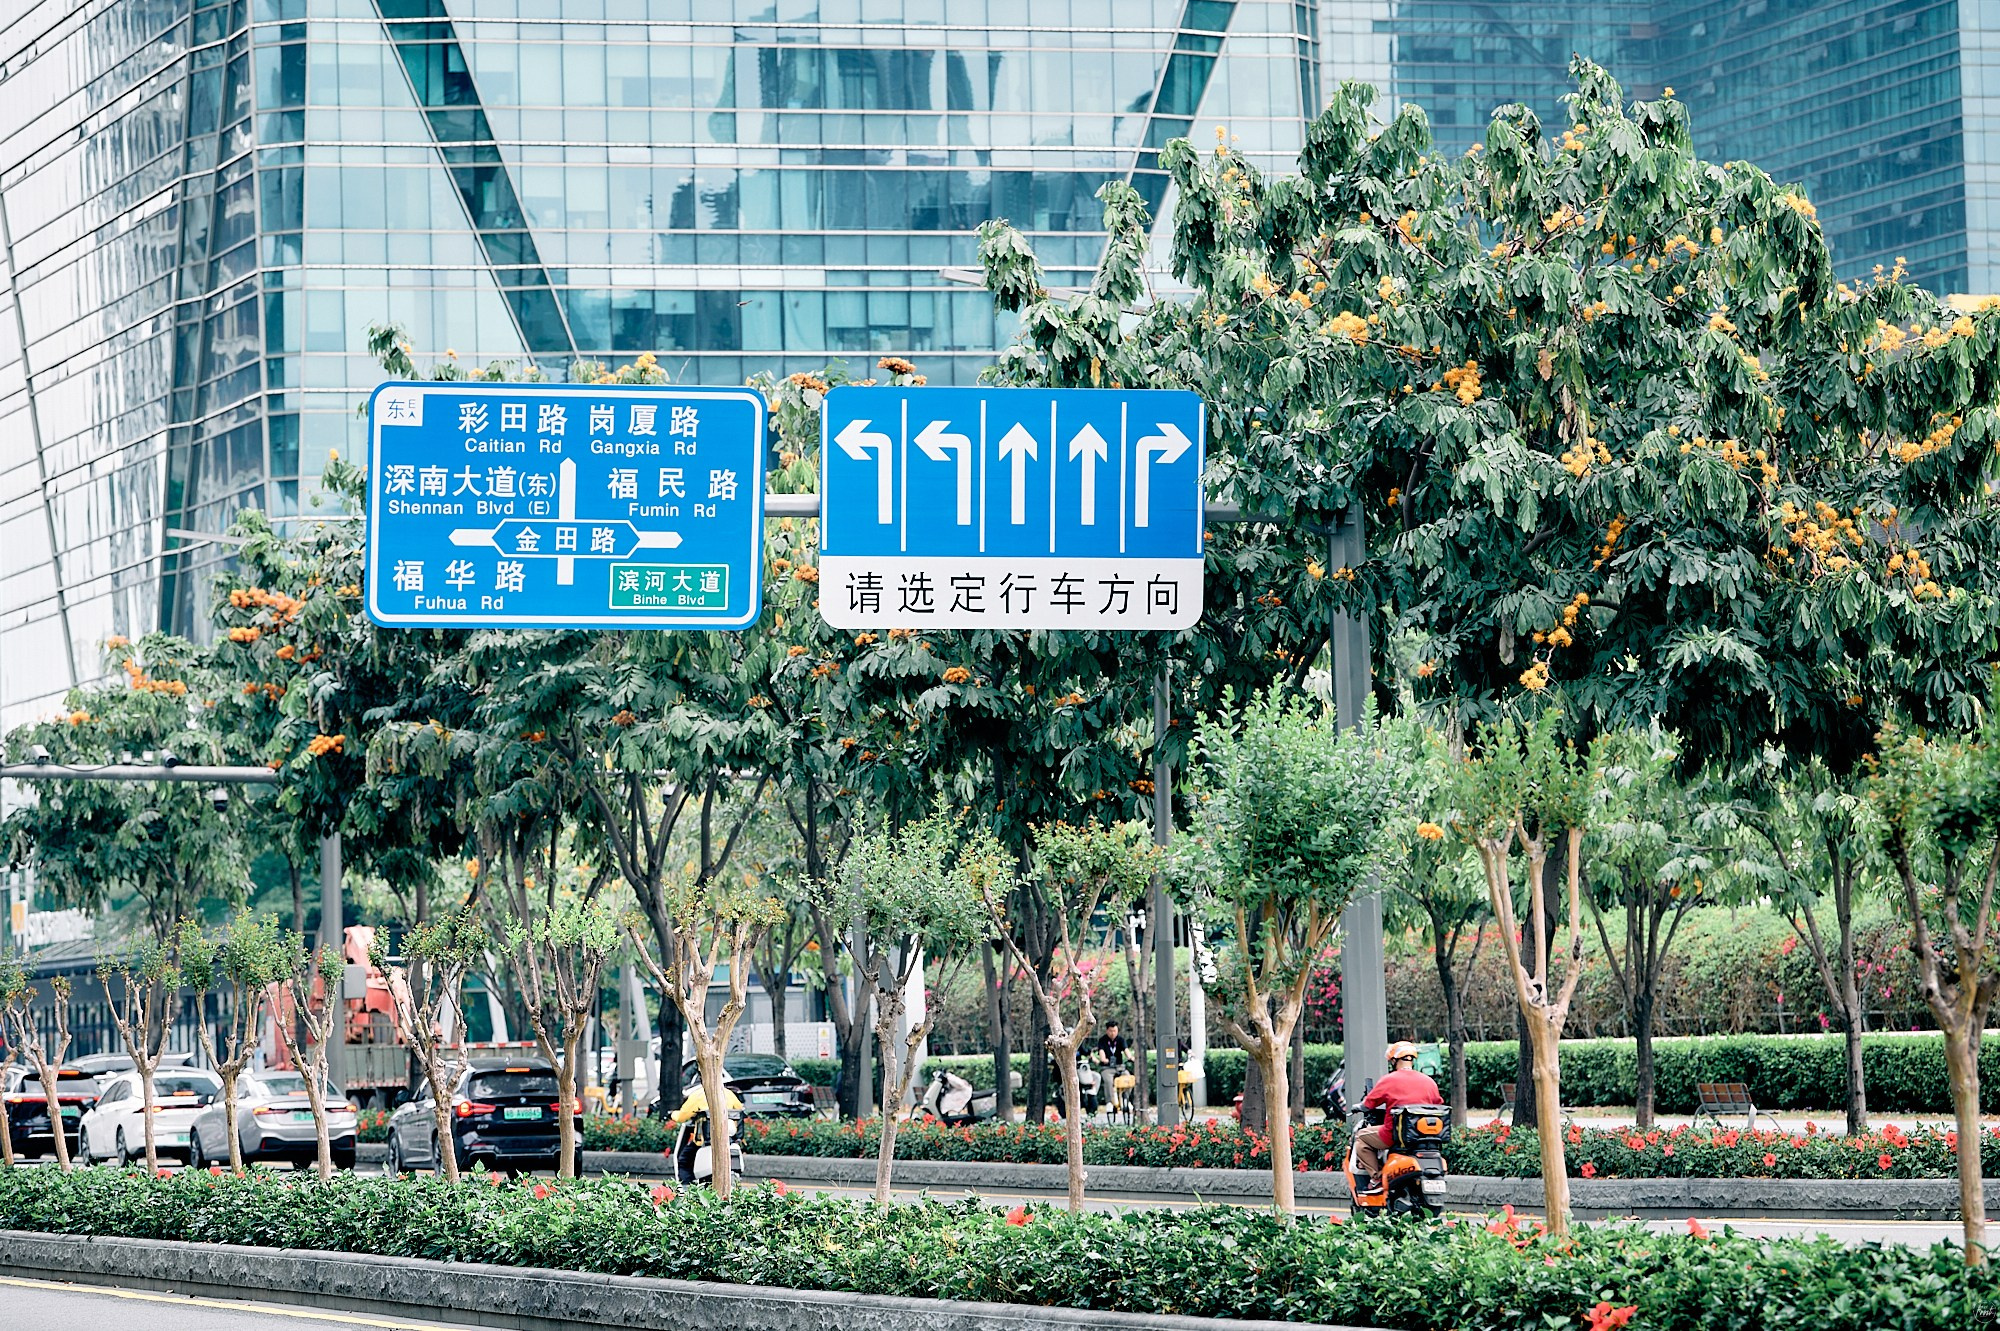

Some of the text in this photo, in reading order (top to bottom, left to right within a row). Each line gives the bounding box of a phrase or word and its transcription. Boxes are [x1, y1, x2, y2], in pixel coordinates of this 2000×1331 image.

[387, 399, 405, 419] 东
[408, 399, 416, 408] E
[459, 402, 567, 436] 彩田路
[590, 403, 699, 437] 岗厦路
[464, 438, 562, 454] Caitian Rd
[591, 440, 697, 458] Gangxia Rd
[608, 468, 739, 501] 福民路
[388, 500, 551, 515] Shennan Blvd (E)
[628, 503, 716, 518] Fumin Rd
[515, 526, 616, 554] 金田路
[393, 560, 526, 593] 福华路
[618, 570, 721, 593] 滨河大道
[414, 595, 504, 611] Fuhua Rd
[633, 594, 705, 606] Binhe Blvd
[845, 572, 1179, 615] 请选定行车方向
